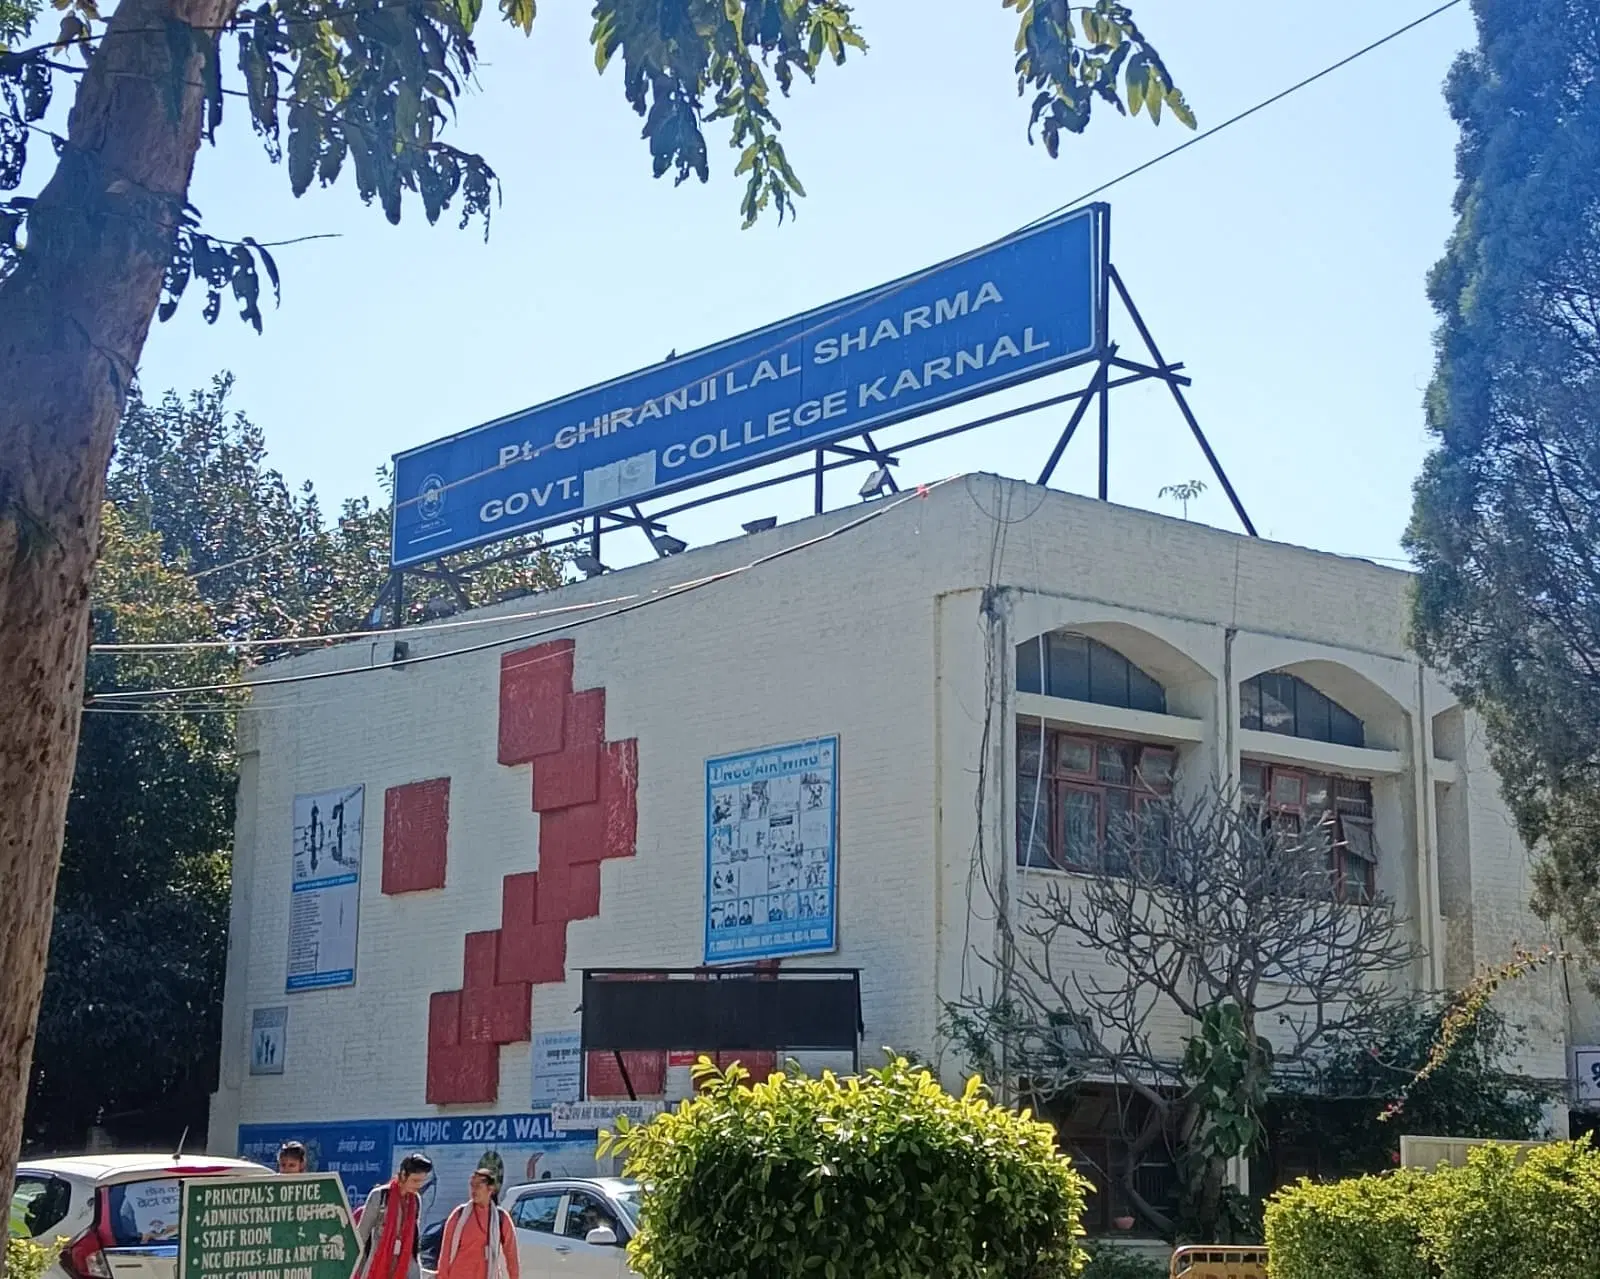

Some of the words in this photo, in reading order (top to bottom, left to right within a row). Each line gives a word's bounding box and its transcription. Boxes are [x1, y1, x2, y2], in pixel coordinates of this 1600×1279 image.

[499, 444, 540, 468] Pt.
[814, 281, 1004, 366] SHARMA
[479, 475, 580, 523] GOVT.
[662, 389, 848, 469] COLLEGE
[858, 327, 1050, 408] KARNAL
[397, 1121, 451, 1142] OLYMPIC
[461, 1119, 508, 1140] 2024
[204, 1185, 274, 1206] PRINCIPAL'S
[280, 1183, 321, 1202] OFFICE
[201, 1206, 294, 1226] ADMINISTRATIVE
[202, 1230, 236, 1248] STAFF
[240, 1227, 272, 1246] ROOM
[201, 1251, 221, 1270] NCC
